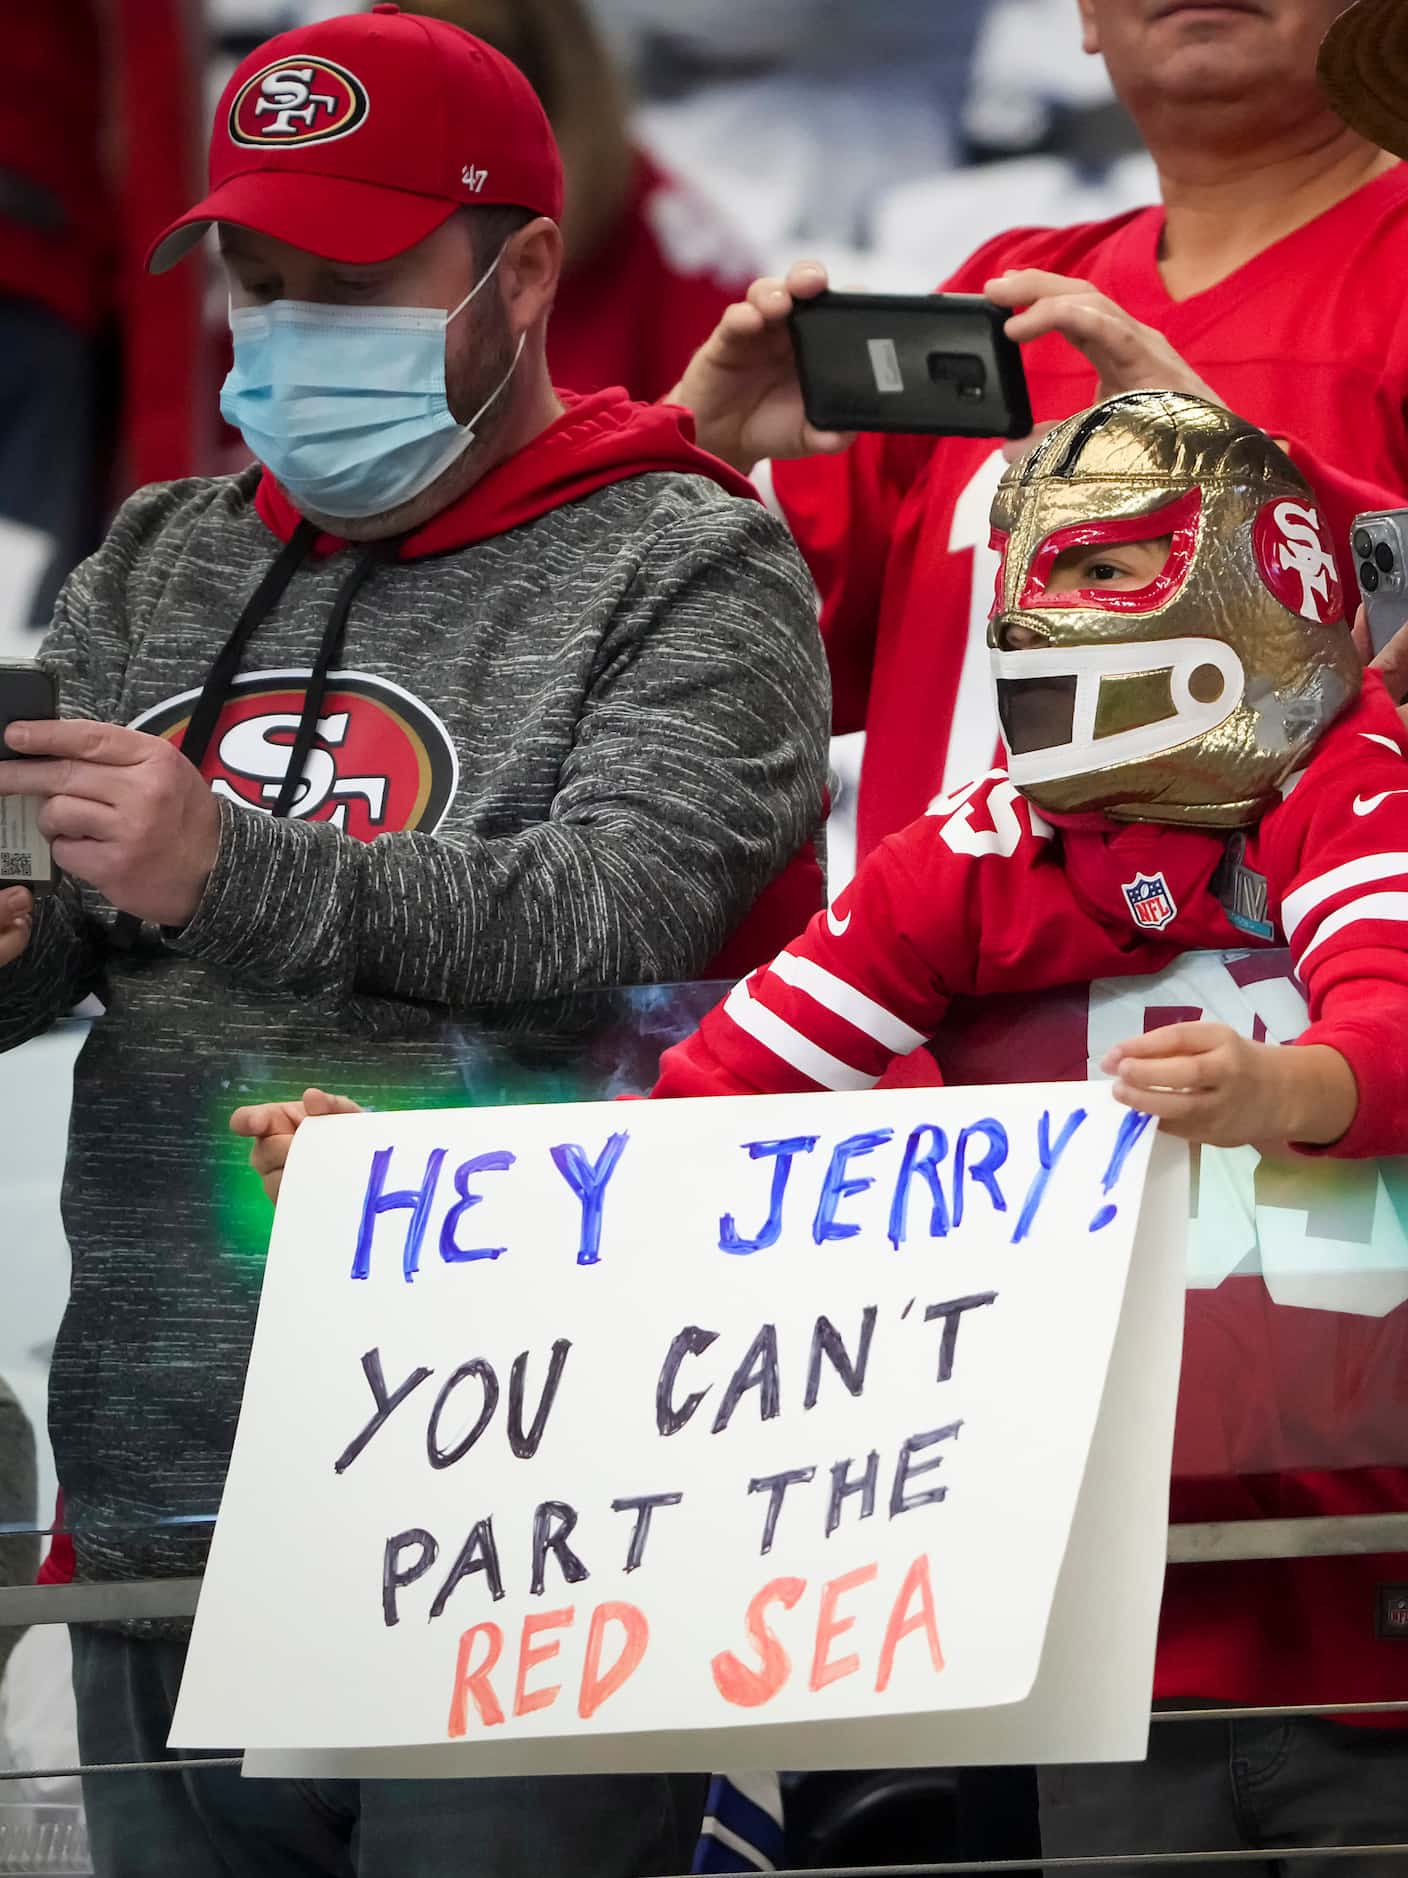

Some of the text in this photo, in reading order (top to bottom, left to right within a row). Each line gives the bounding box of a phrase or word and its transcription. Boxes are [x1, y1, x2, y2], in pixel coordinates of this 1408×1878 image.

[255, 68, 336, 134] SF
[1135, 896, 1170, 924] NFL
[350, 1107, 1154, 1284] HEY JERRY!
[334, 1290, 999, 1475] YOU CAN'T
[381, 1419, 965, 1628] PART THE
[447, 1553, 946, 1739] RED SEA
